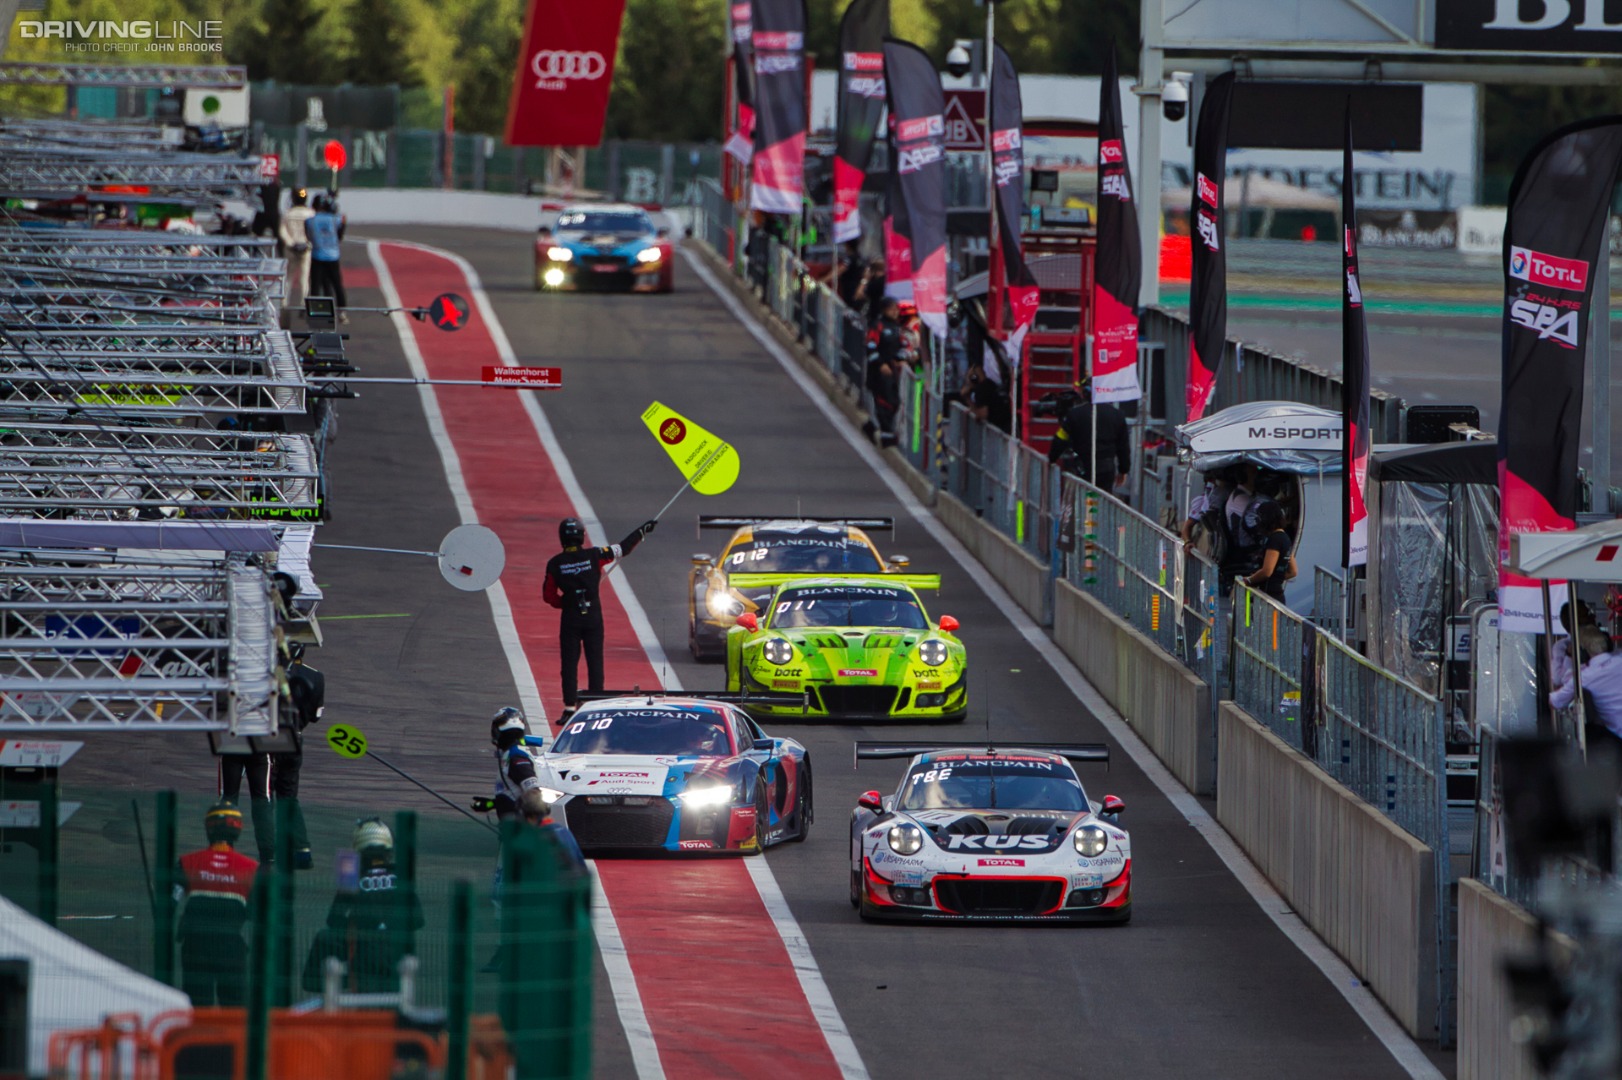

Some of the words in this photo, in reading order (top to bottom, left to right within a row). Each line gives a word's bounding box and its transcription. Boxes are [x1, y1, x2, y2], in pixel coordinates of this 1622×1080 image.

[1532, 257, 1582, 284] TOTL
[1510, 299, 1578, 346] SPA
[494, 367, 550, 377] Walkenhorst
[1248, 427, 1342, 440] M-SPORT
[753, 538, 847, 550] BLANCPAIN
[797, 588, 898, 597] BLANCPAIN
[774, 668, 803, 677] bott
[913, 669, 940, 678] bott
[587, 710, 700, 720] BLANCPAIN
[330, 728, 364, 754] 25
[932, 760, 1052, 770] BLANCPAIN
[681, 841, 712, 849] TOTAL
